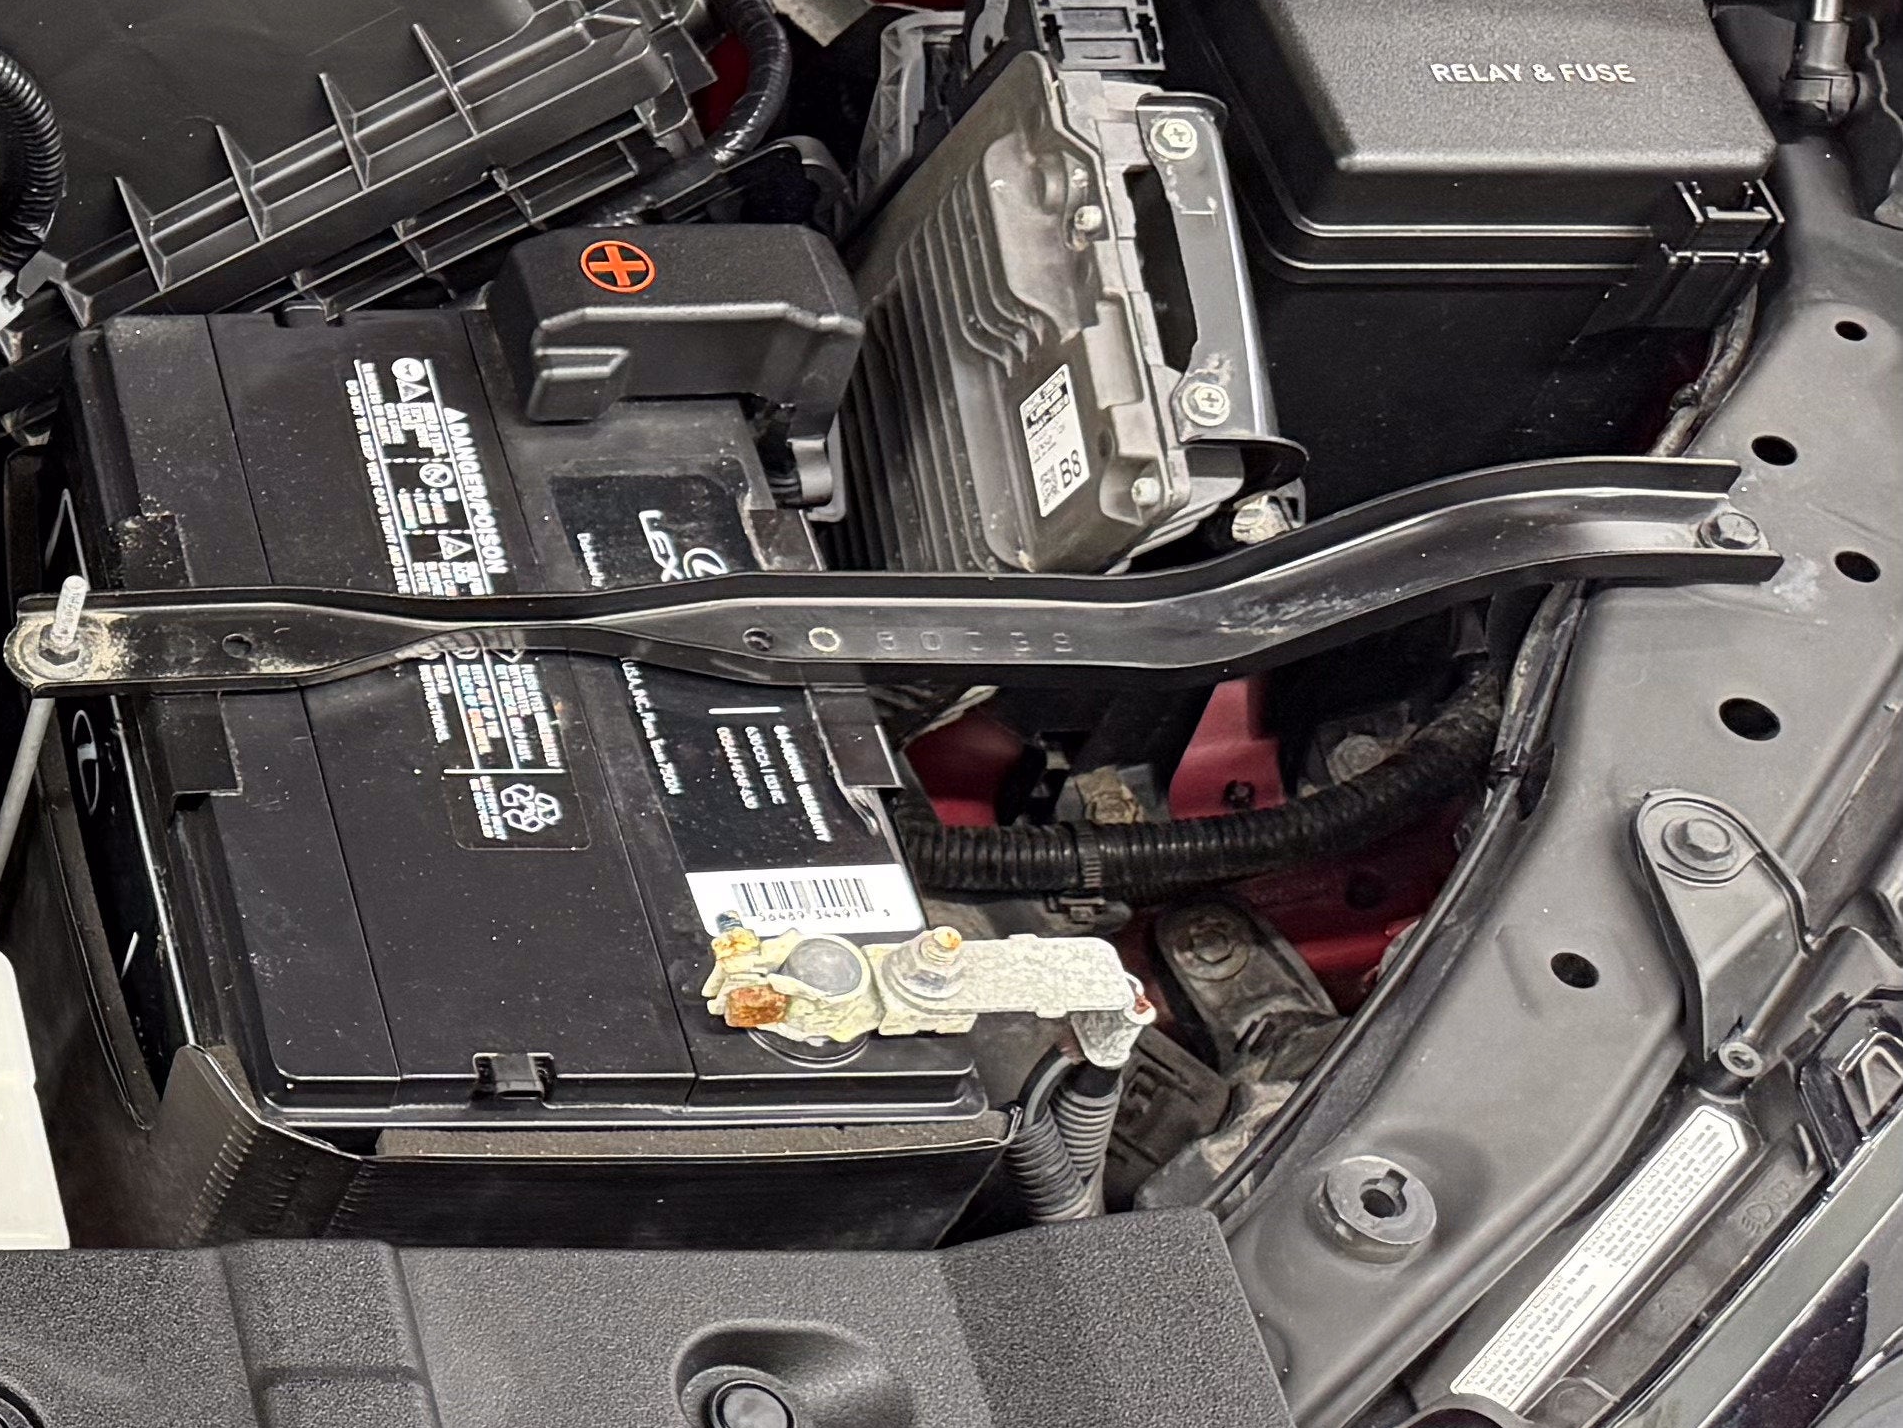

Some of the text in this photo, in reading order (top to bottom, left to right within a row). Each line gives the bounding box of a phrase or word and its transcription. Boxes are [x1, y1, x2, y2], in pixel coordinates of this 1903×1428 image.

[1430, 63, 1637, 85] RELAY & FUSE
[1059, 449, 1082, 489] B8
[637, 510, 684, 583] LEX
